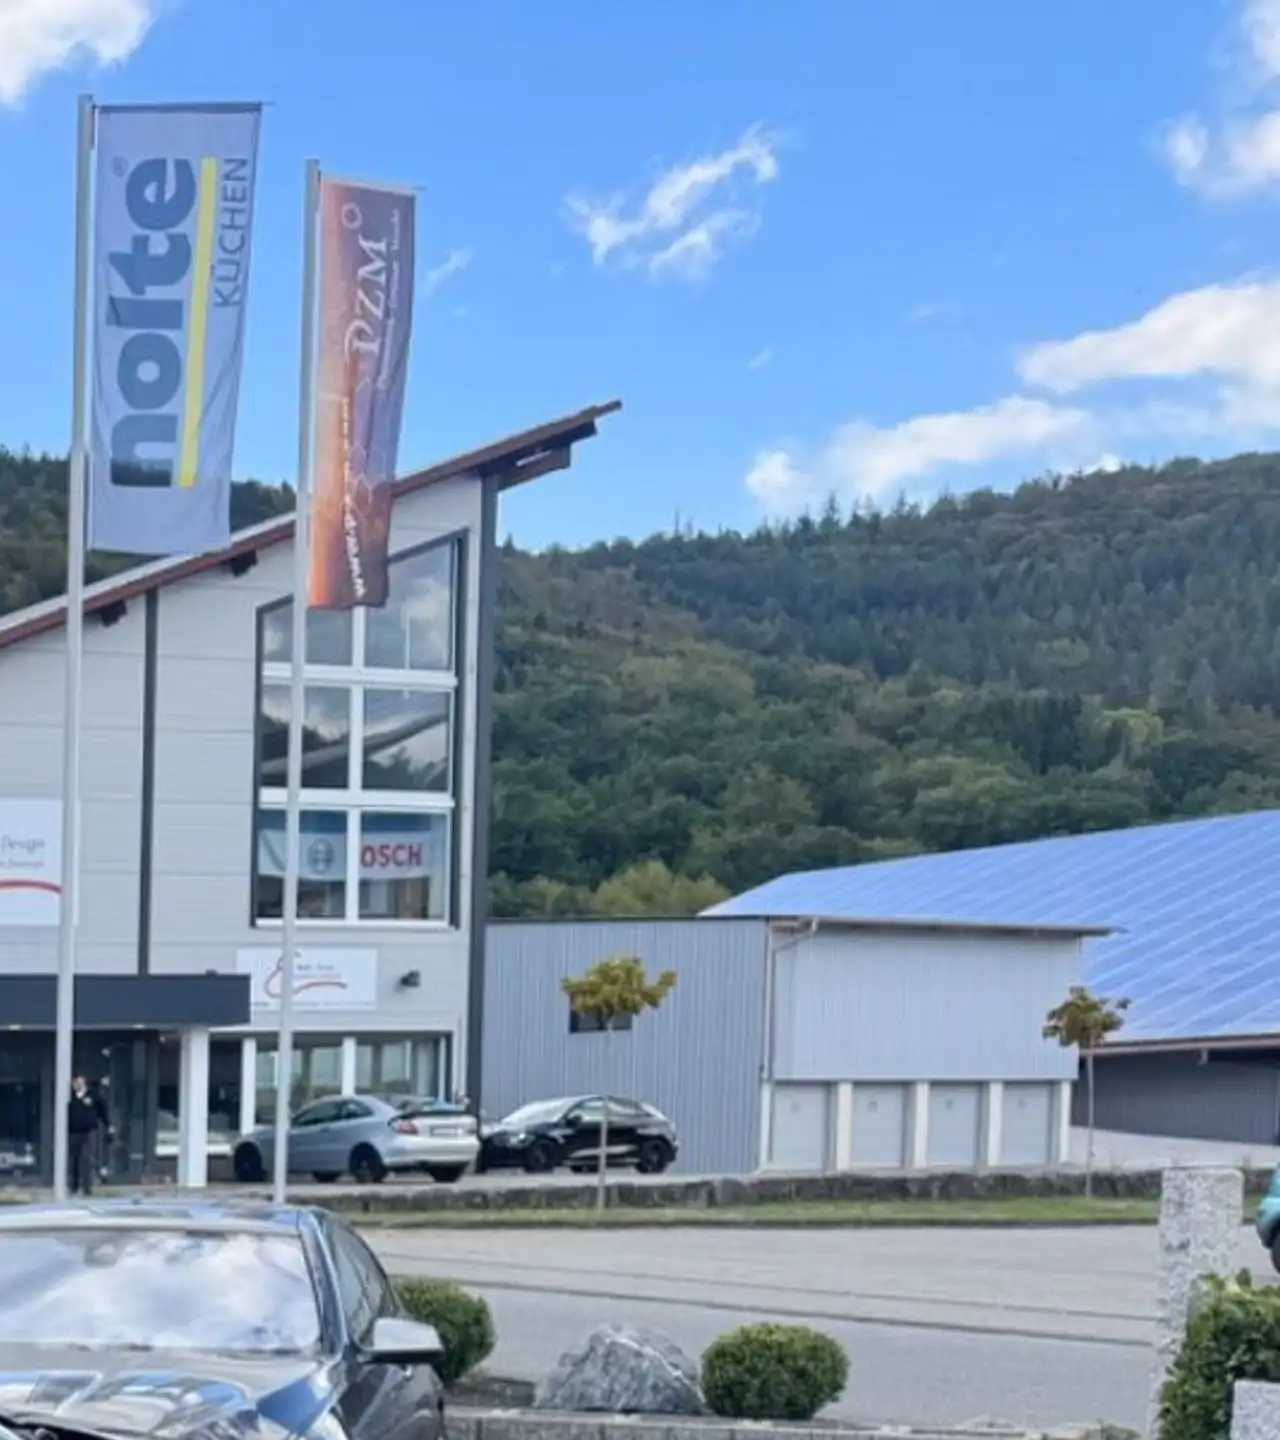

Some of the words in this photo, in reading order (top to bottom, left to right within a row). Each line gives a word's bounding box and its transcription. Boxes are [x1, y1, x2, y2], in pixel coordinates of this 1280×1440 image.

[210, 157, 249, 308] KÜCHEN
[106, 157, 197, 488] nolte
[359, 842, 424, 869] OSCH
